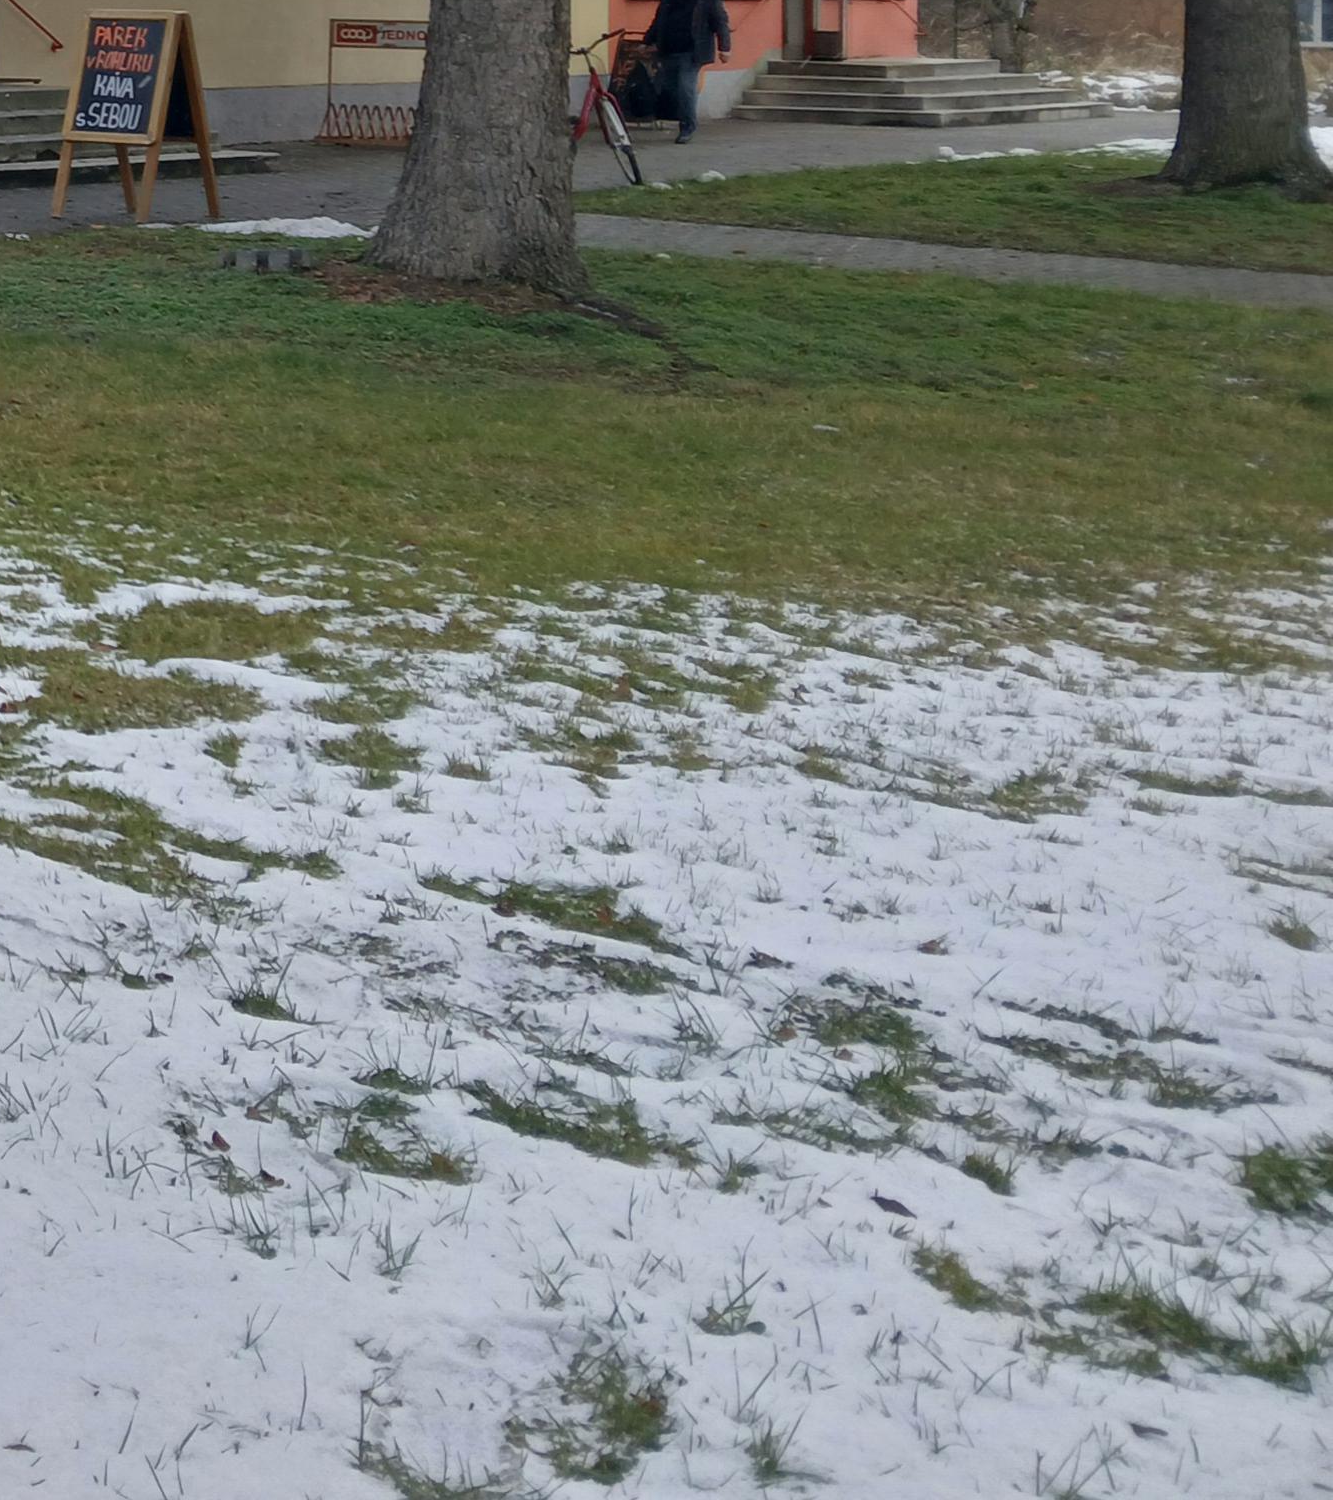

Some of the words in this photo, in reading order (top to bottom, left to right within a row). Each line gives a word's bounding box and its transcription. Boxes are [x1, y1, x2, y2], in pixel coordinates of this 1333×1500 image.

[94, 21, 148, 48] PÁREK
[340, 28, 373, 41] coop
[379, 29, 428, 41] JEDNO
[93, 71, 134, 99] KÁVA
[86, 102, 142, 130] SEBOU
